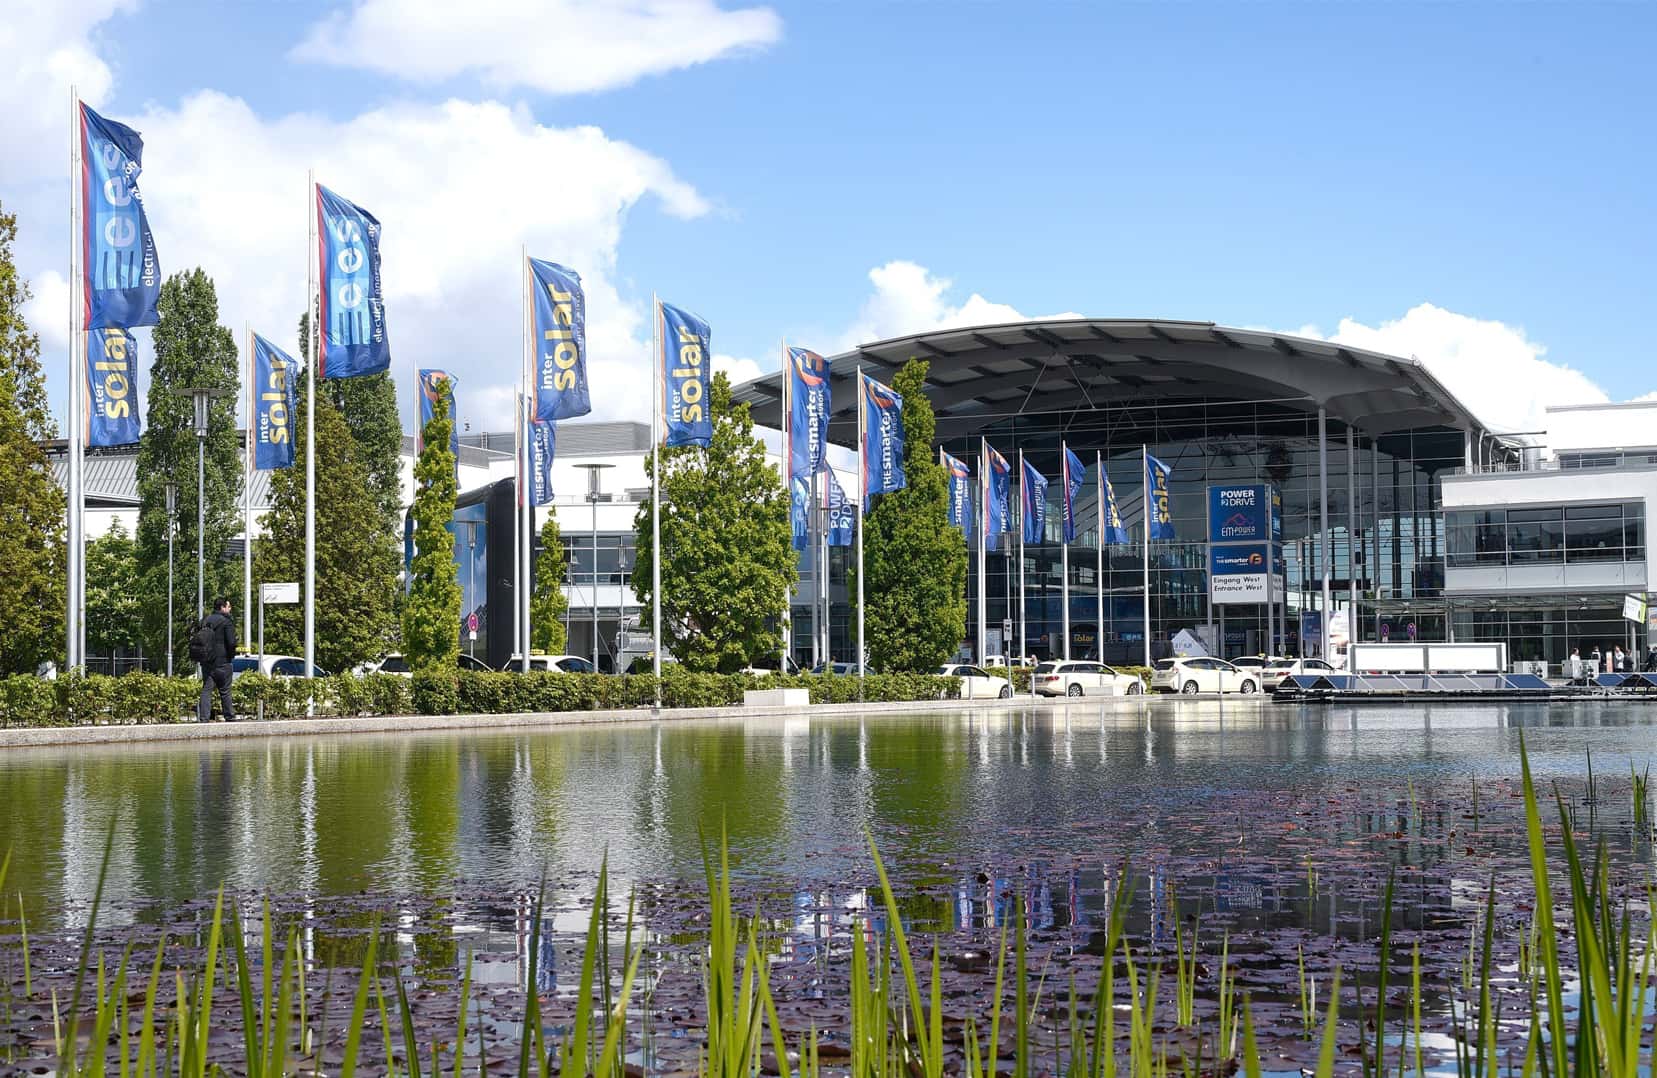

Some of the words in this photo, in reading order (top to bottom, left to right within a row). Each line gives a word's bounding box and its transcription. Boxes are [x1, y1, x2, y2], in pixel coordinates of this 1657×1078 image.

[335, 218, 363, 309] ees
[545, 283, 579, 392] solar
[541, 352, 553, 390] inter
[672, 326, 702, 424] solar
[96, 382, 105, 417] inter
[262, 352, 289, 445] solar
[670, 389, 681, 422] inter
[259, 412, 269, 443] inter
[1152, 466, 1169, 524] solar
[1221, 490, 1254, 498] POWER
[1151, 502, 1159, 523] inter
[1213, 577, 1241, 585] Eingang
[1214, 584, 1243, 592] Entrance
